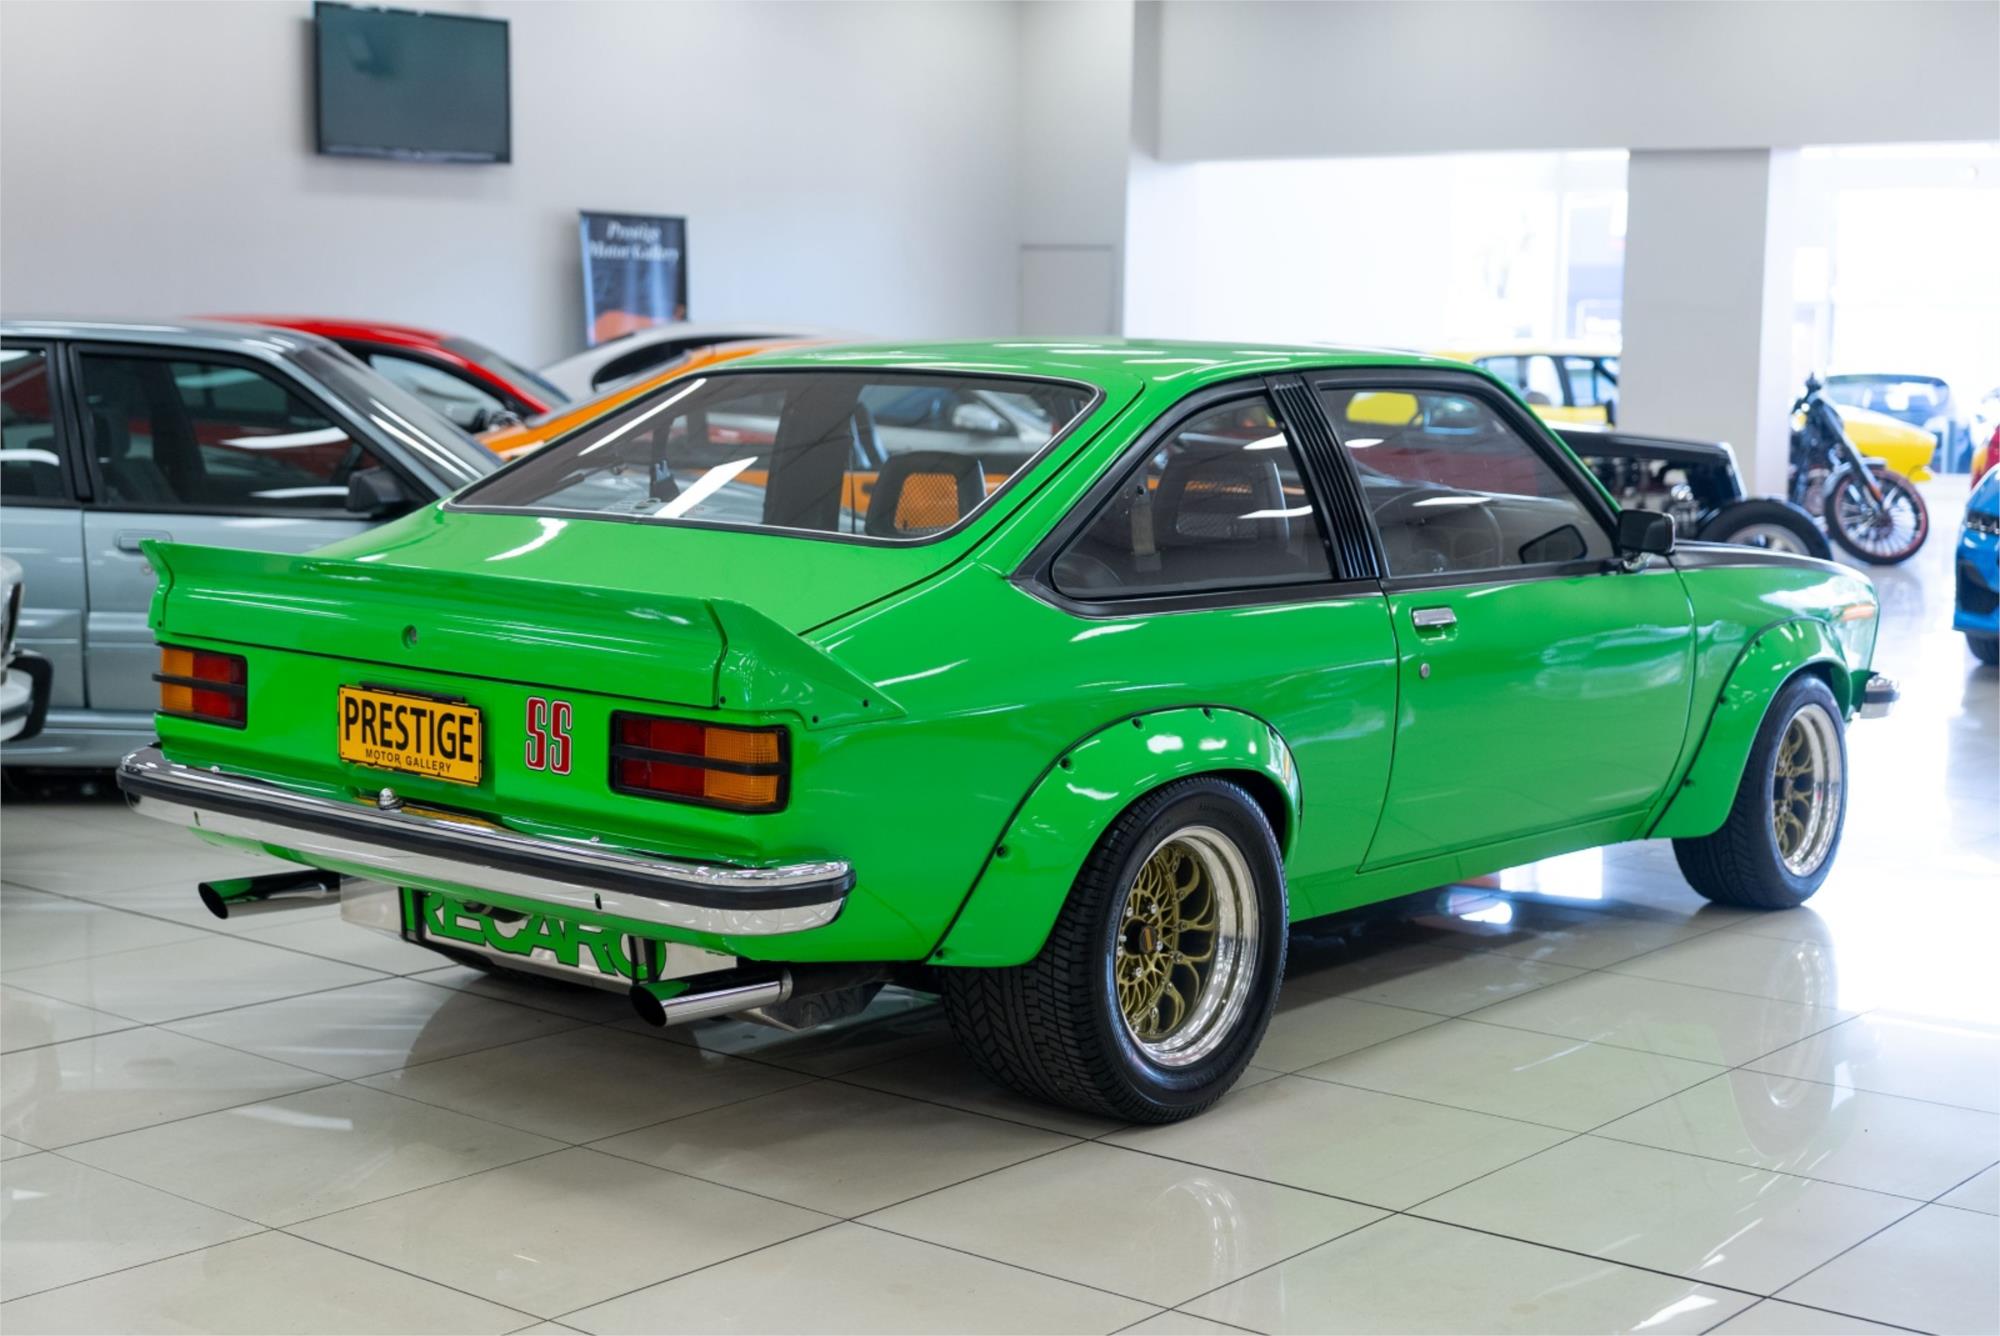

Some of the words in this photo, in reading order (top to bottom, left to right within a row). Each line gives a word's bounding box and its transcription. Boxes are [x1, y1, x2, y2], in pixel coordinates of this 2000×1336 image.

[344, 695, 474, 763] PRESTIGE
[365, 748, 400, 764] MOTOR
[405, 755, 452, 773] GALLERY
[525, 696, 572, 777] SS
[399, 886, 666, 980] RECARO
